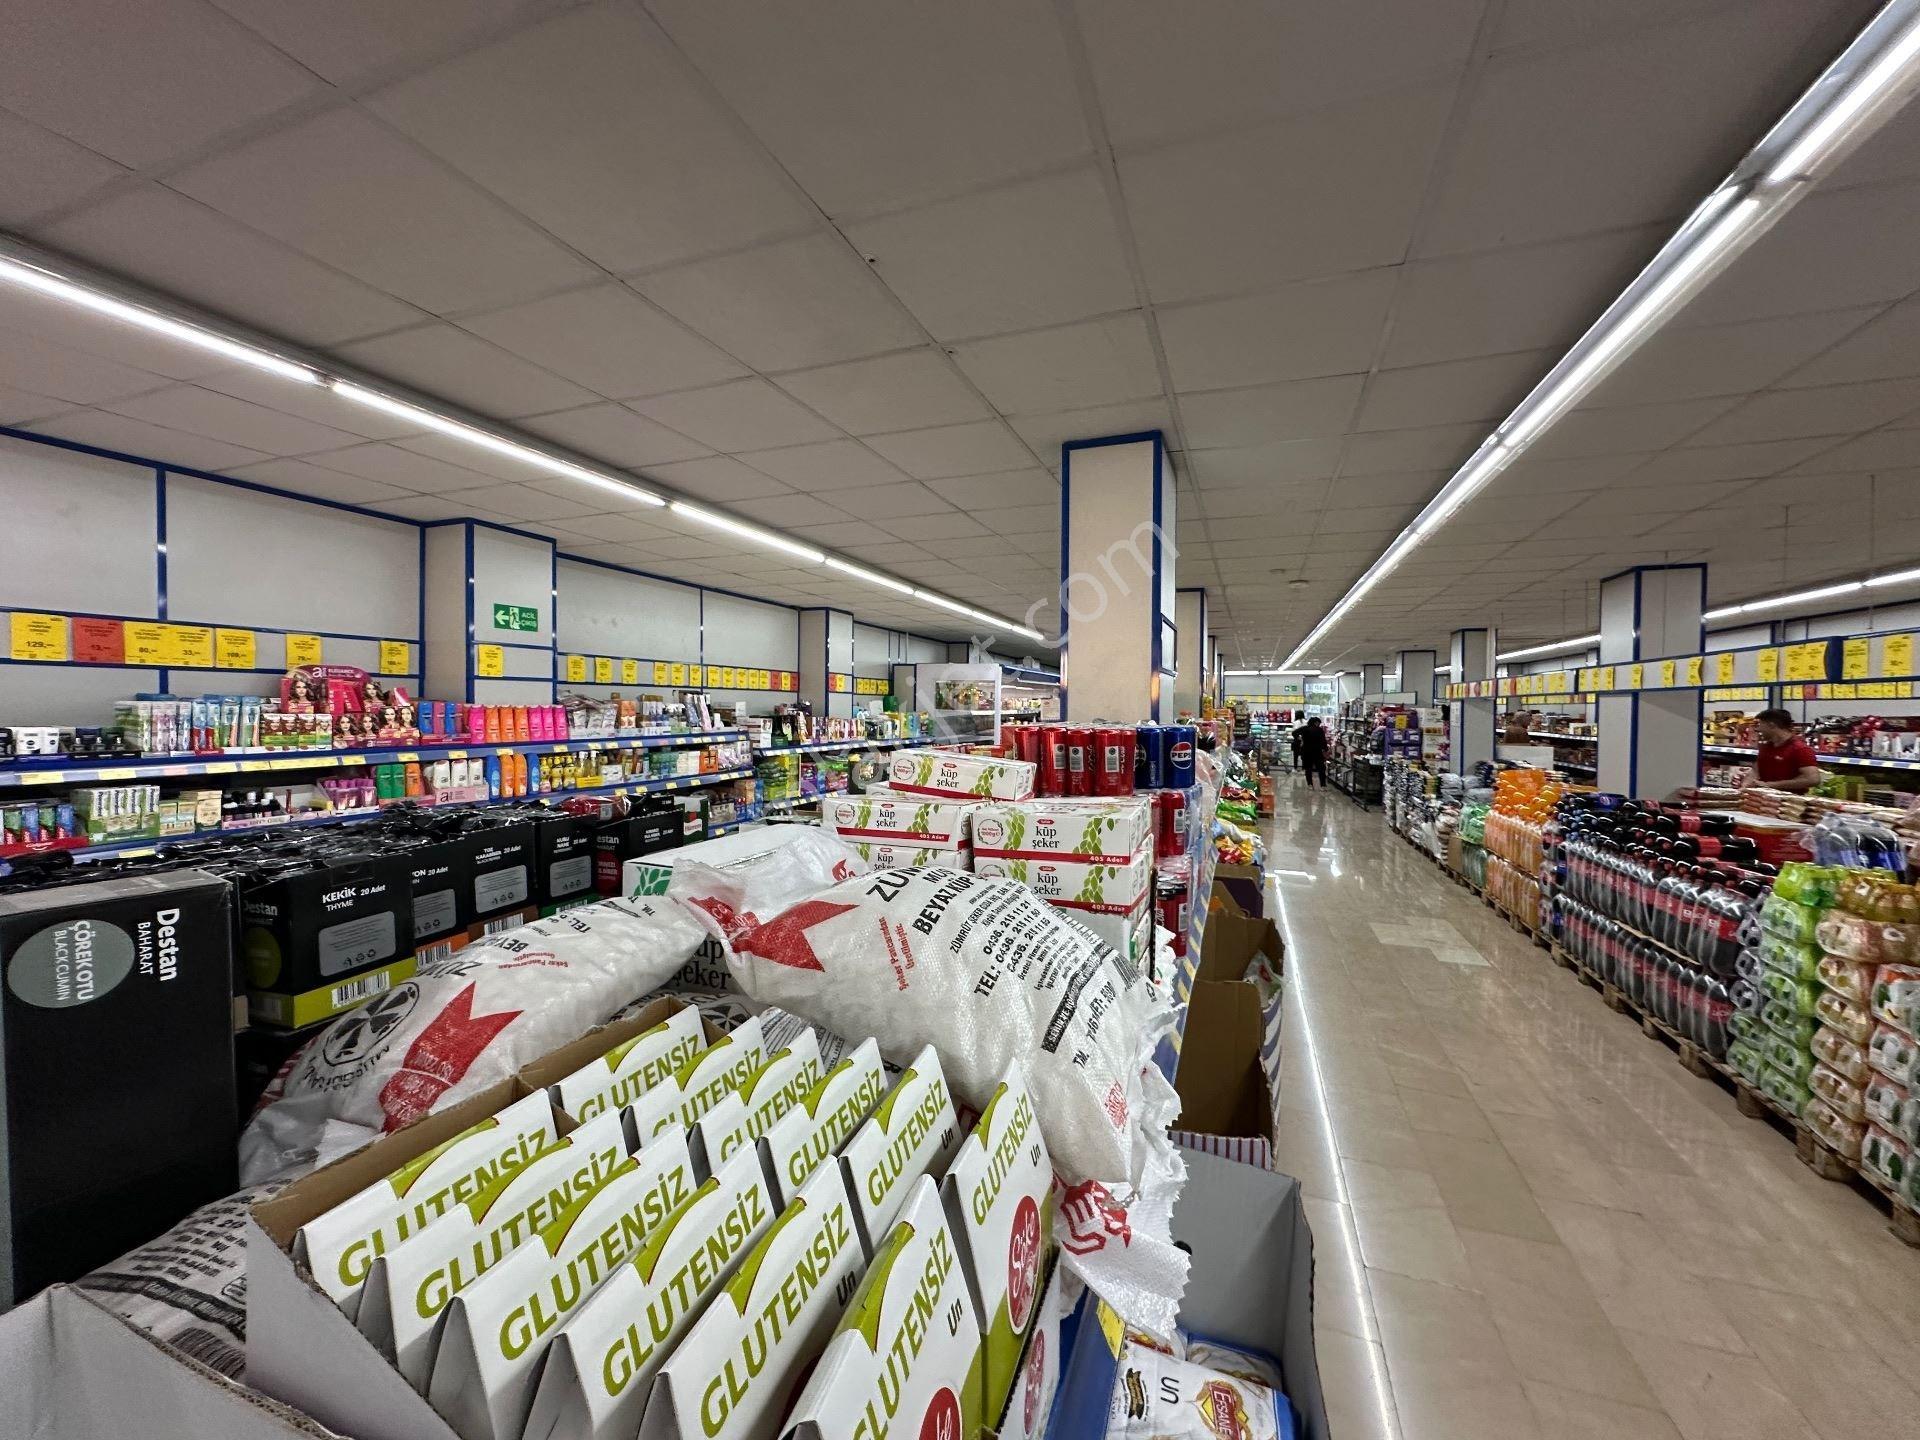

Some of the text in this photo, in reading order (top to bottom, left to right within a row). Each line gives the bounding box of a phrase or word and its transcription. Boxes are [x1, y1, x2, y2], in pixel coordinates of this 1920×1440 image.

[936, 778, 960, 789] şeker
[596, 835, 620, 845] estan
[876, 819, 898, 829] şeker
[1031, 837, 1060, 850] şeker
[322, 884, 386, 904] KEKİK 20 Adet
[325, 899, 354, 912] THYME
[912, 876, 975, 936] BEYAZ KÜP
[1000, 913, 1016, 928] 215
[1012, 907, 1024, 916] 11
[1020, 900, 1032, 909] 21
[137, 921, 154, 976] BAHARAT
[156, 908, 181, 982] Destan
[949, 920, 972, 954] ZÜMRÜT
[974, 965, 1002, 998] TEL:
[788, 1065, 886, 1188] GLUTENSİZ
[867, 1078, 949, 1207] GLUTENSİZ
[941, 1127, 954, 1150] Un
[972, 1092, 1034, 1226] GLUTENSİZ
[1030, 1143, 1042, 1168] Un
[415, 1146, 620, 1319] GLUTENSİZ
[498, 1165, 690, 1361] GLUTENSİZ
[602, 1183, 766, 1397] GLUTENSİZ
[836, 1270, 857, 1306] Un
[701, 1202, 851, 1439] GLUTENSİZ
[947, 1297, 964, 1337] Un
